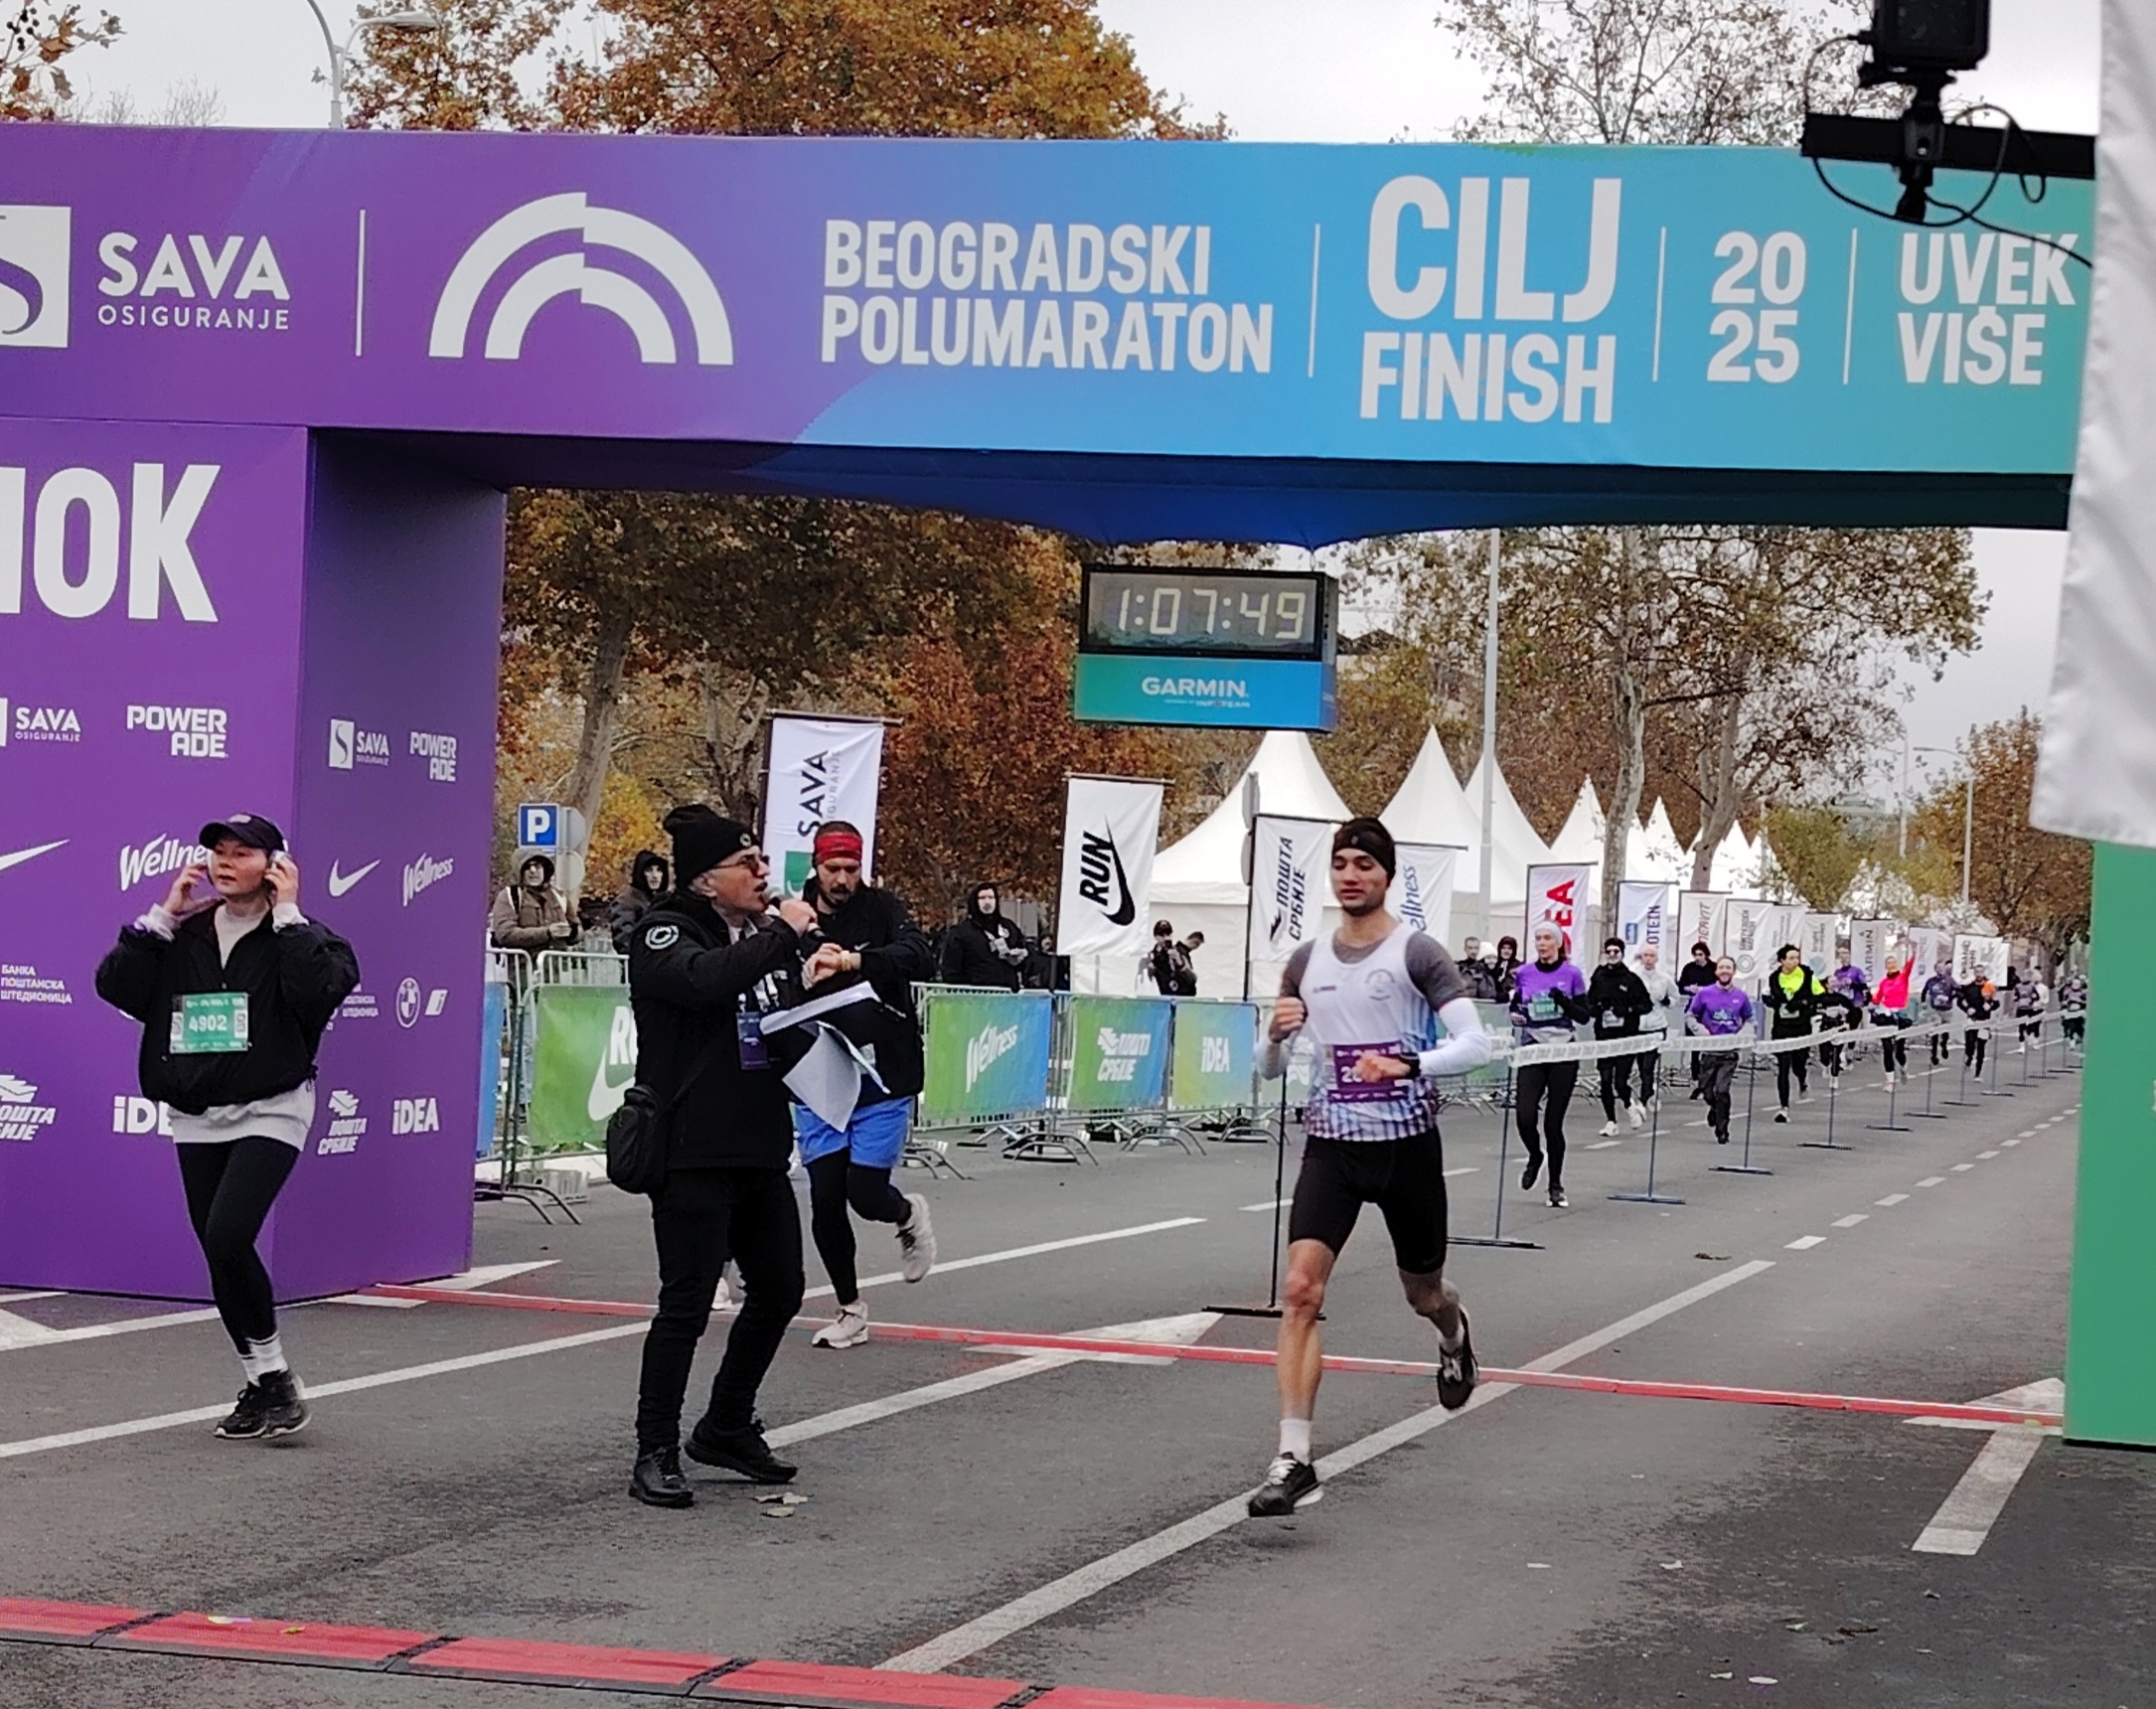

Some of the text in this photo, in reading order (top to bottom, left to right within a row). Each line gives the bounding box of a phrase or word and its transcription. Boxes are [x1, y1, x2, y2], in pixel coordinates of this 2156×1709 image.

[98, 233, 290, 300] SAVA
[824, 220, 1210, 295] BEOGRADSKI
[1367, 175, 1621, 323] CILJ
[1711, 231, 1806, 305] 20
[1900, 232, 2079, 305] UVEK
[97, 305, 290, 331] OSIGURANJE
[821, 295, 1274, 374] POLUMARATON
[1706, 310, 1800, 383] 25
[1898, 306, 2046, 386] VIŠE
[1360, 332, 1617, 424] FINISH
[1119, 587, 1307, 639] 1:07:49
[1141, 677, 1247, 698] GARMIN
[15, 706, 81, 733] SAVA
[15, 730, 81, 743] OSIGURANJE
[126, 704, 228, 733] POWER
[171, 731, 228, 758] ADE
[356, 730, 390, 756] SAVA
[409, 731, 457, 759] POWER
[429, 757, 457, 782] ADE
[797, 749, 829, 838] SAVA
[527, 809, 550, 843] P
[119, 833, 208, 892] Wellne
[402, 852, 455, 907] Wellness
[1079, 830, 1113, 907] RUN
[1276, 836, 1293, 908] ПОШТА
[1289, 866, 1306, 942] СРБИЈЕ
[1400, 863, 1428, 932] ellness
[1, 964, 37, 977] БАНКА
[1, 977, 66, 991] ПОШТАНСКА
[1, 990, 73, 1005] ШТЕДИОНИЦА
[189, 1014, 228, 1032] 4902
[966, 1020, 1019, 1094] Wellness
[0, 1105, 57, 1125] ОШТА
[113, 1095, 175, 1136] iDE
